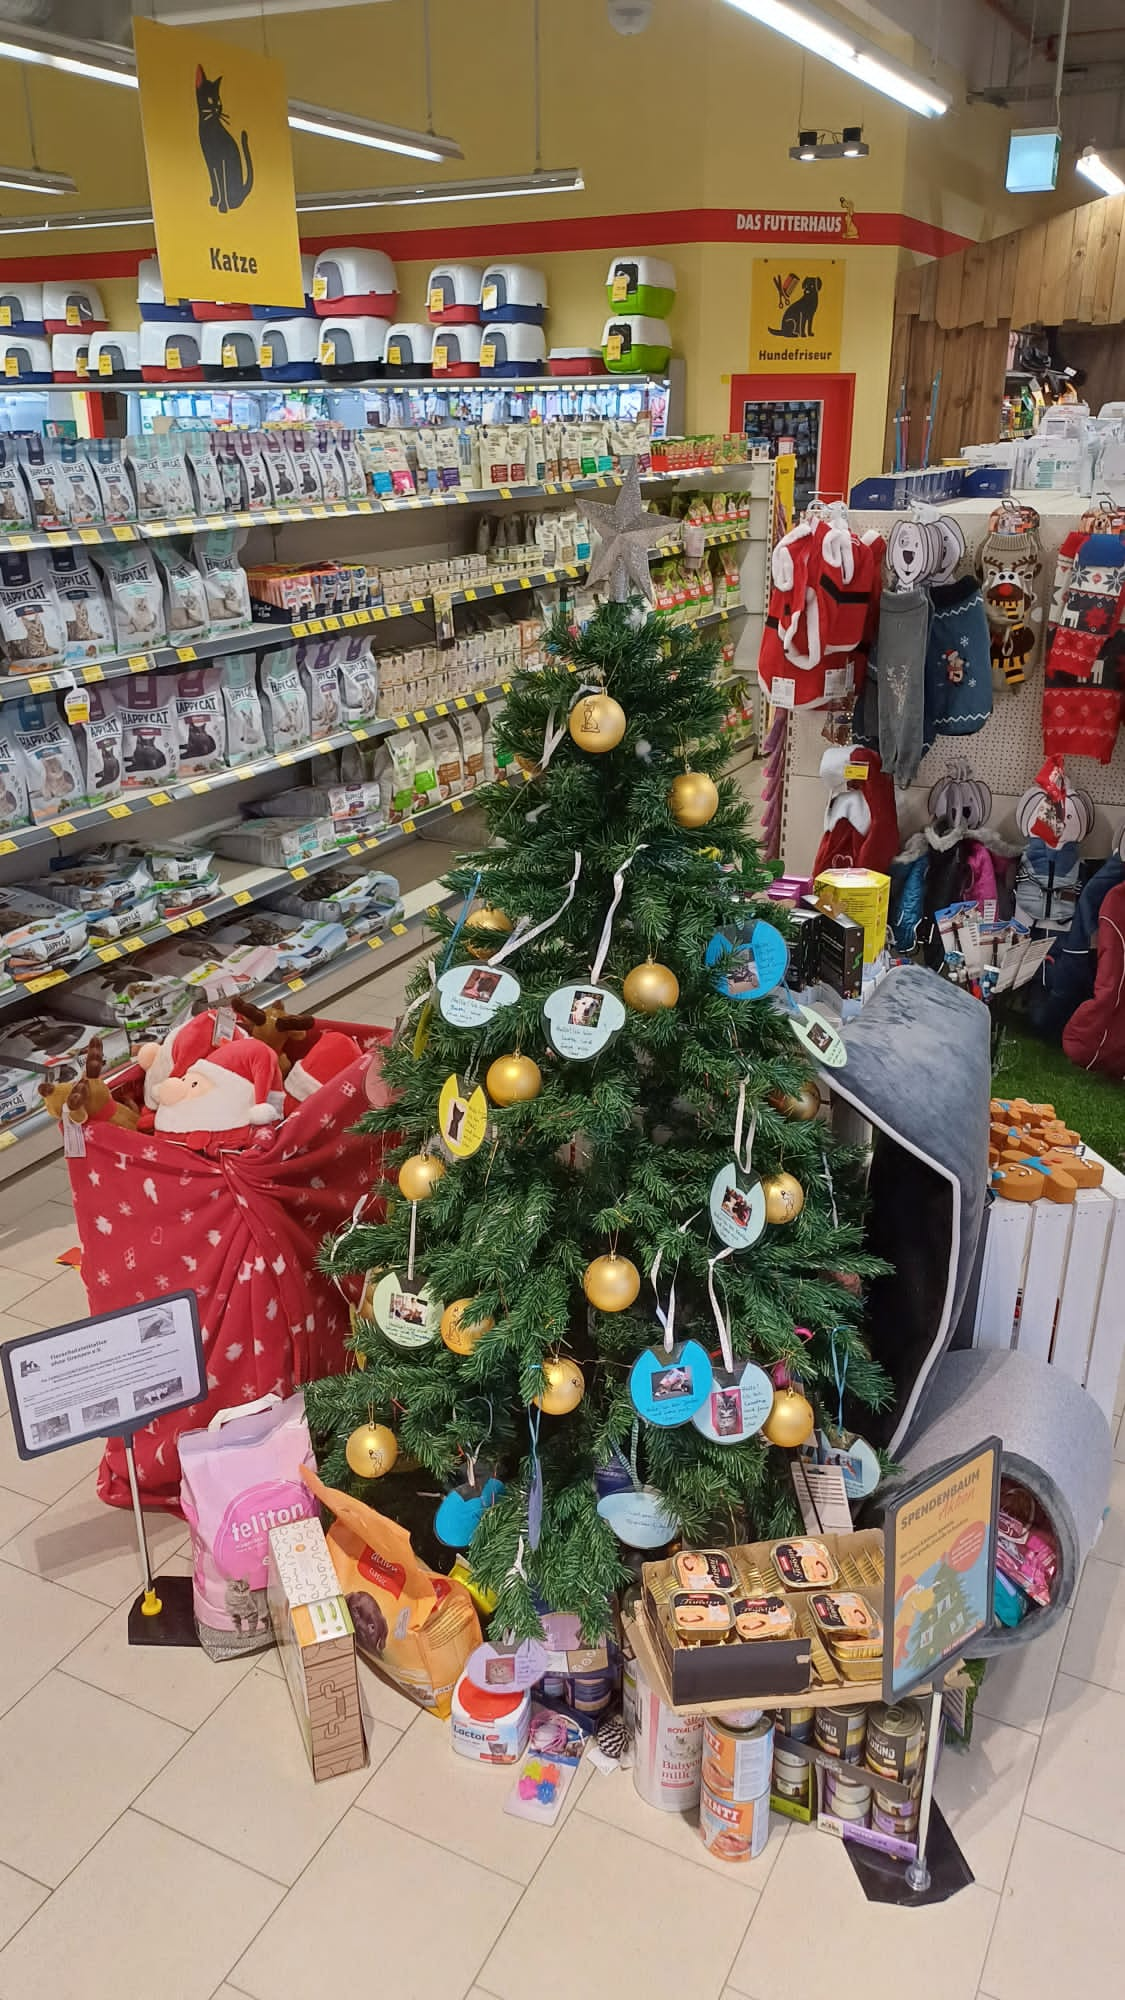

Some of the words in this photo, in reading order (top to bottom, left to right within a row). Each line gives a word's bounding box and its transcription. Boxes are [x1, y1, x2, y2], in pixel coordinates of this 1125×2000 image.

[736, 213, 761, 230] DAS
[764, 214, 842, 232] FUTTERHAUS
[209, 247, 258, 274] Katze
[758, 349, 832, 361] Hundefriseur
[73, 572, 91, 586] CAT
[133, 566, 149, 581] CAT
[0, 589, 26, 605] HAPPY
[27, 584, 46, 600] CAT
[199, 698, 217, 712] CAT
[121, 711, 149, 724] HAPPY
[150, 711, 168, 724] CAT
[107, 718, 121, 733] CAT
[45, 727, 63, 744] CAT
[61, 934, 72, 946] CAT
[13, 1094, 25, 1107] CAT
[900, 1468, 981, 1531] SPENDENBAUM
[454, 1724, 485, 1741] Lactol
[661, 1770, 691, 1779] milk
